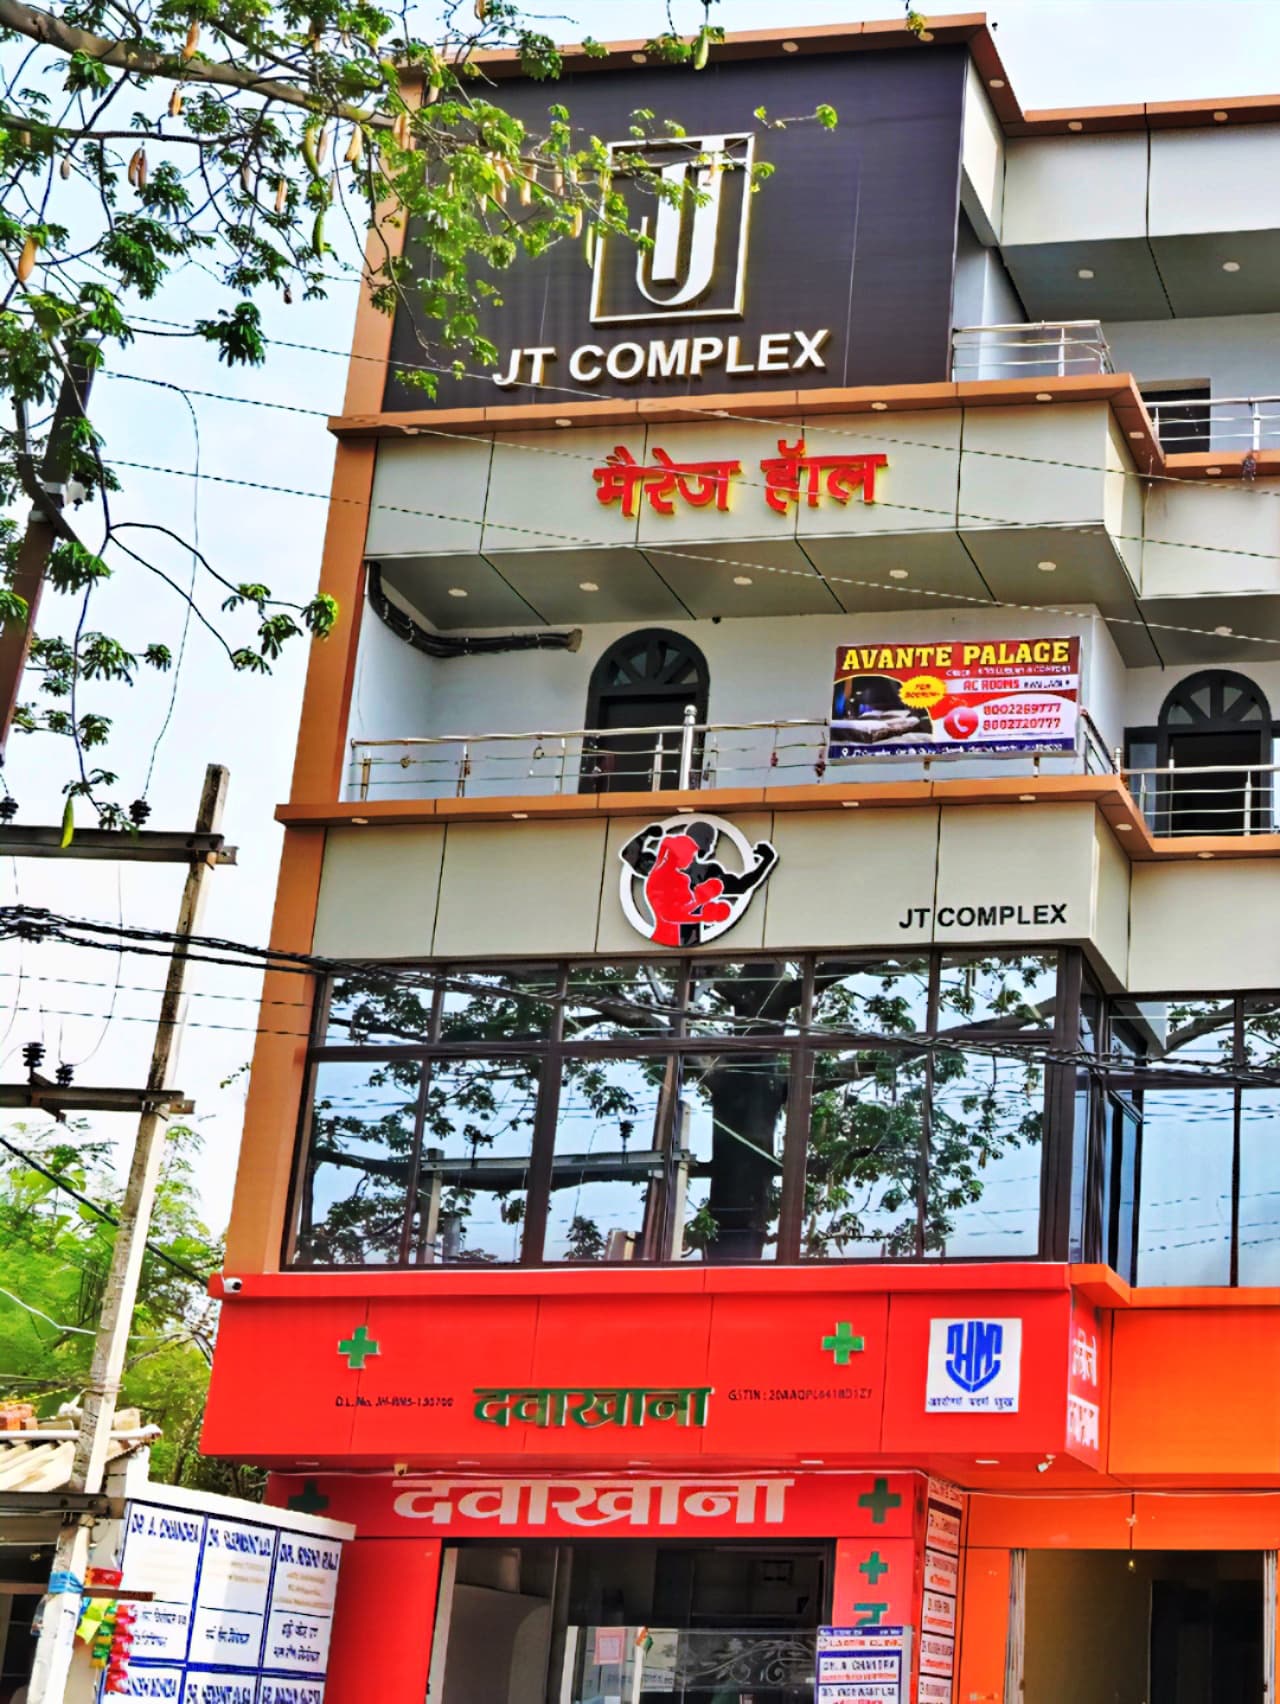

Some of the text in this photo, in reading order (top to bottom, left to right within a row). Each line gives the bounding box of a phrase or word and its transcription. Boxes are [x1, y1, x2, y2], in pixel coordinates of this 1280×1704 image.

[493, 329, 830, 389] JT COMPLEX
[592, 446, 743, 517] मैरेज
[842, 640, 1070, 670] AVANTE PALACE
[899, 903, 1068, 929] JT COMPLEX
[473, 1387, 715, 1429] दवाखाना
[393, 1478, 796, 1527] दवाखाना
